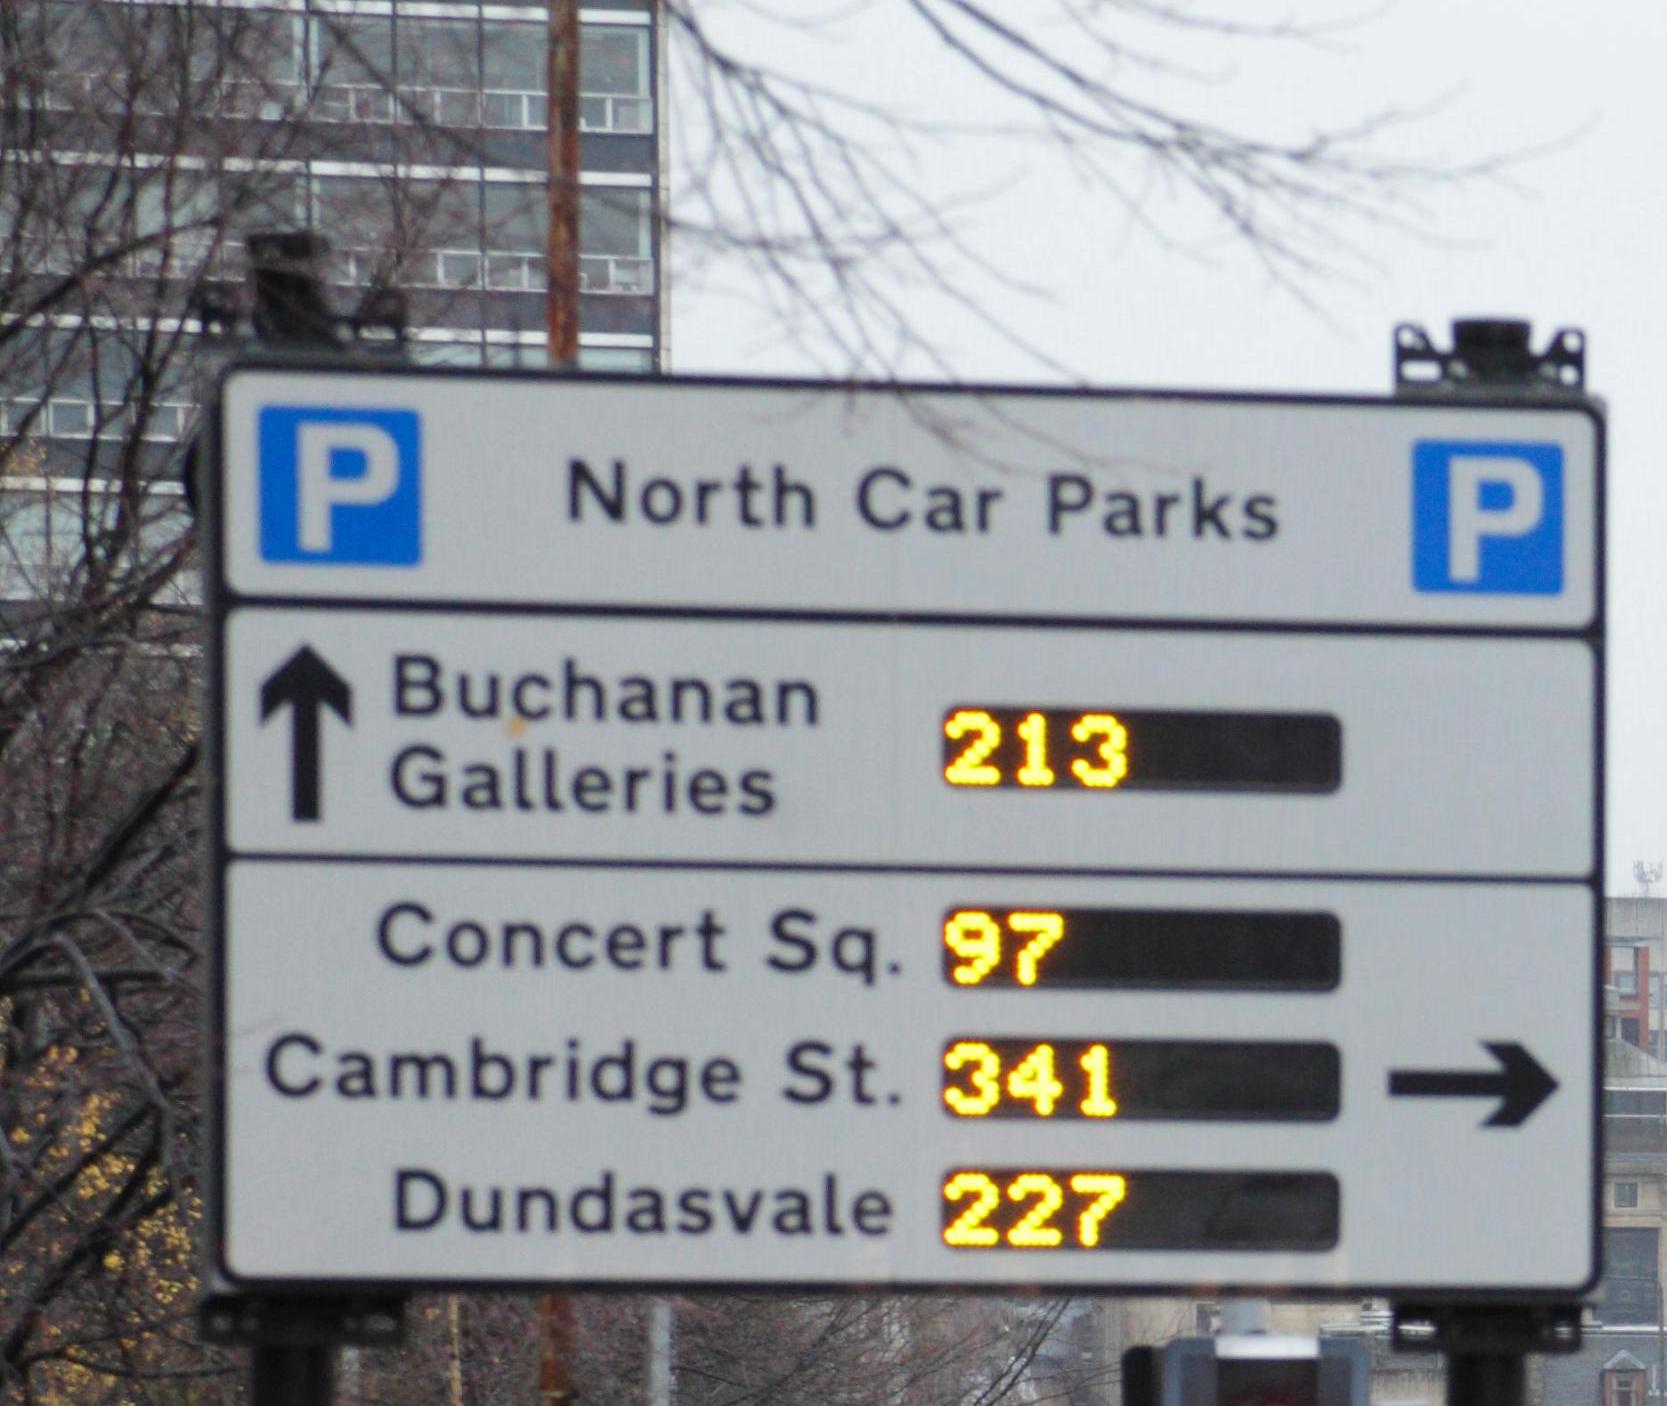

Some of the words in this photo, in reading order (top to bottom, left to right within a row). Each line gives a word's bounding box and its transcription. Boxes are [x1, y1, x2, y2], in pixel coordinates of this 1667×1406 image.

[566, 457, 816, 529] North
[855, 466, 1003, 534] Car
[1047, 472, 1280, 542] Parks
[392, 652, 820, 727] Buchanan
[388, 742, 778, 818] Galleries
[942, 706, 1130, 792] 213
[375, 899, 727, 974] Concert
[766, 907, 902, 988] Sq.
[942, 908, 1066, 989] 97
[263, 1031, 743, 1118] Cambridge
[782, 1038, 902, 1107] St.
[942, 1039, 1119, 1121] 341
[393, 1166, 894, 1238] Dundasvale
[941, 1169, 1128, 1251] 227
